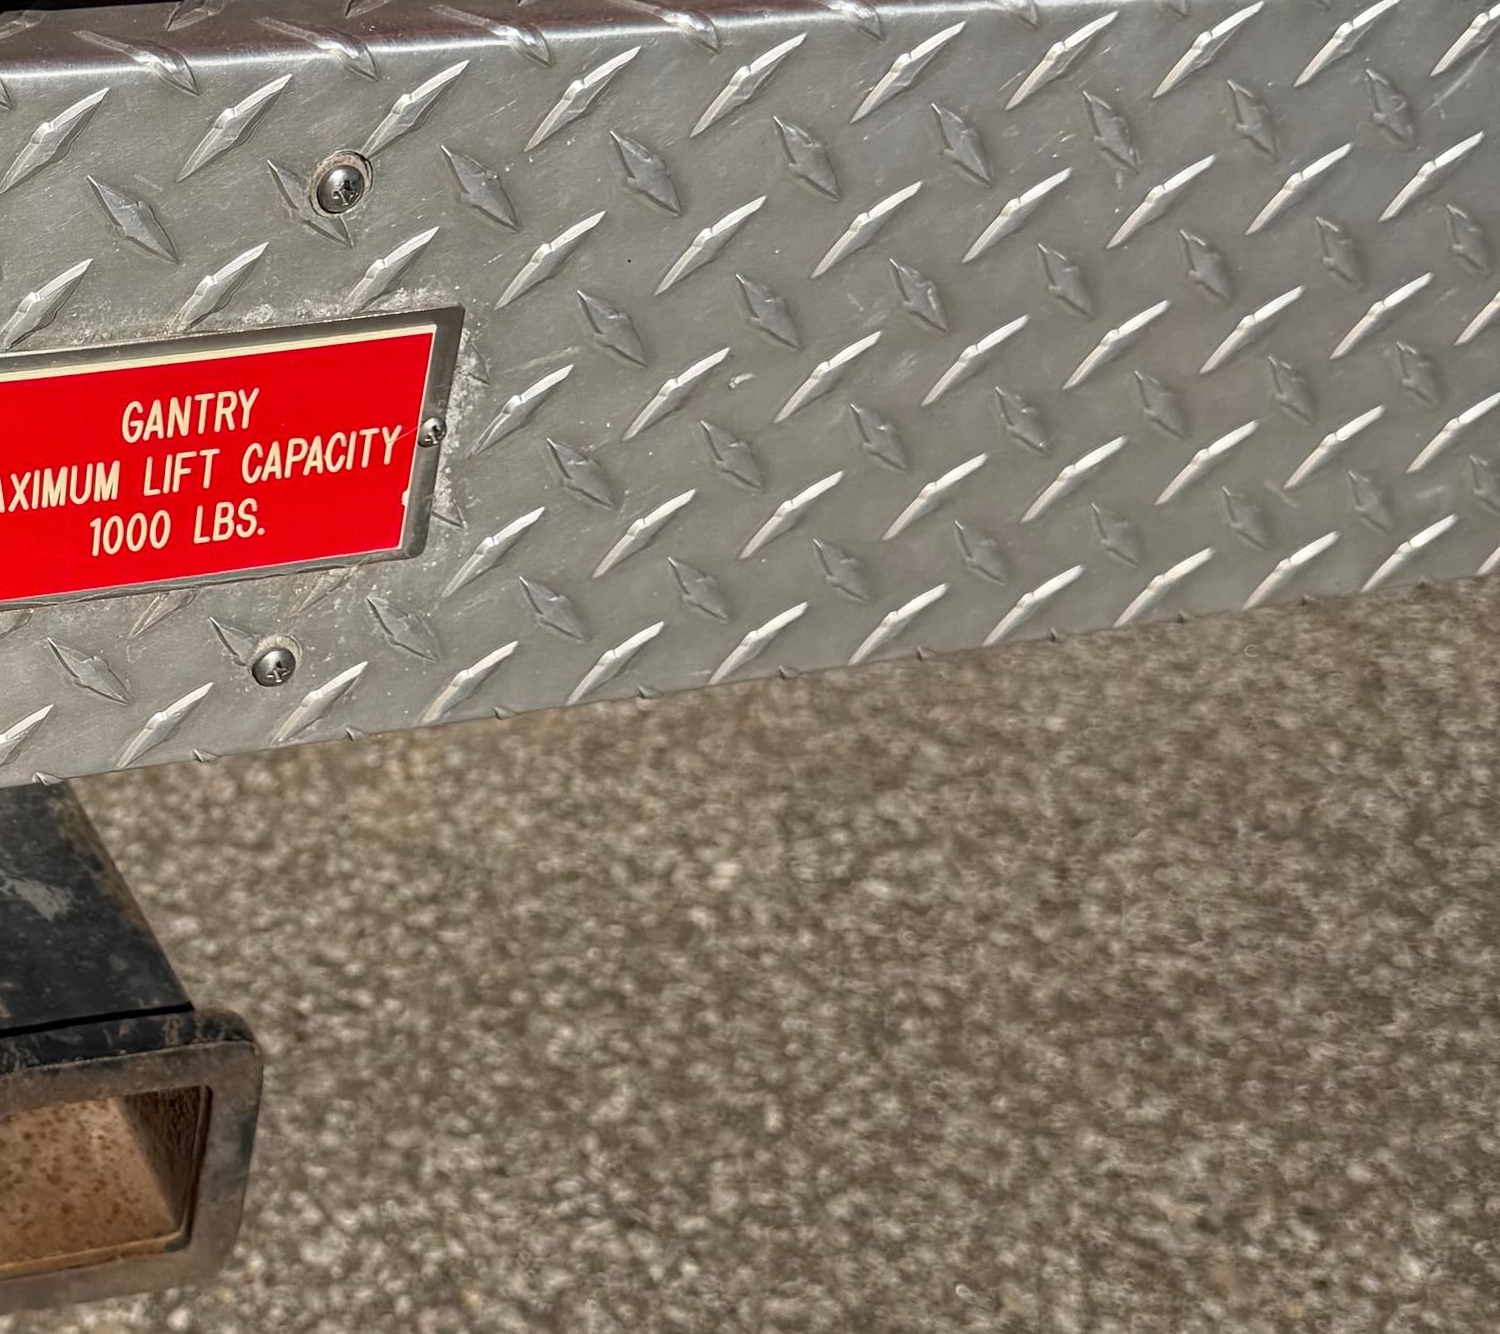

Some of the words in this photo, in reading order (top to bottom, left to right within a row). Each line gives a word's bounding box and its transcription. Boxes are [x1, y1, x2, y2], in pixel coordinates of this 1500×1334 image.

[122, 388, 259, 443] GANTRY
[144, 449, 220, 496] LIFT
[242, 425, 402, 483] CAPACITY
[90, 510, 170, 556] 1000
[194, 498, 265, 543] LBS.
